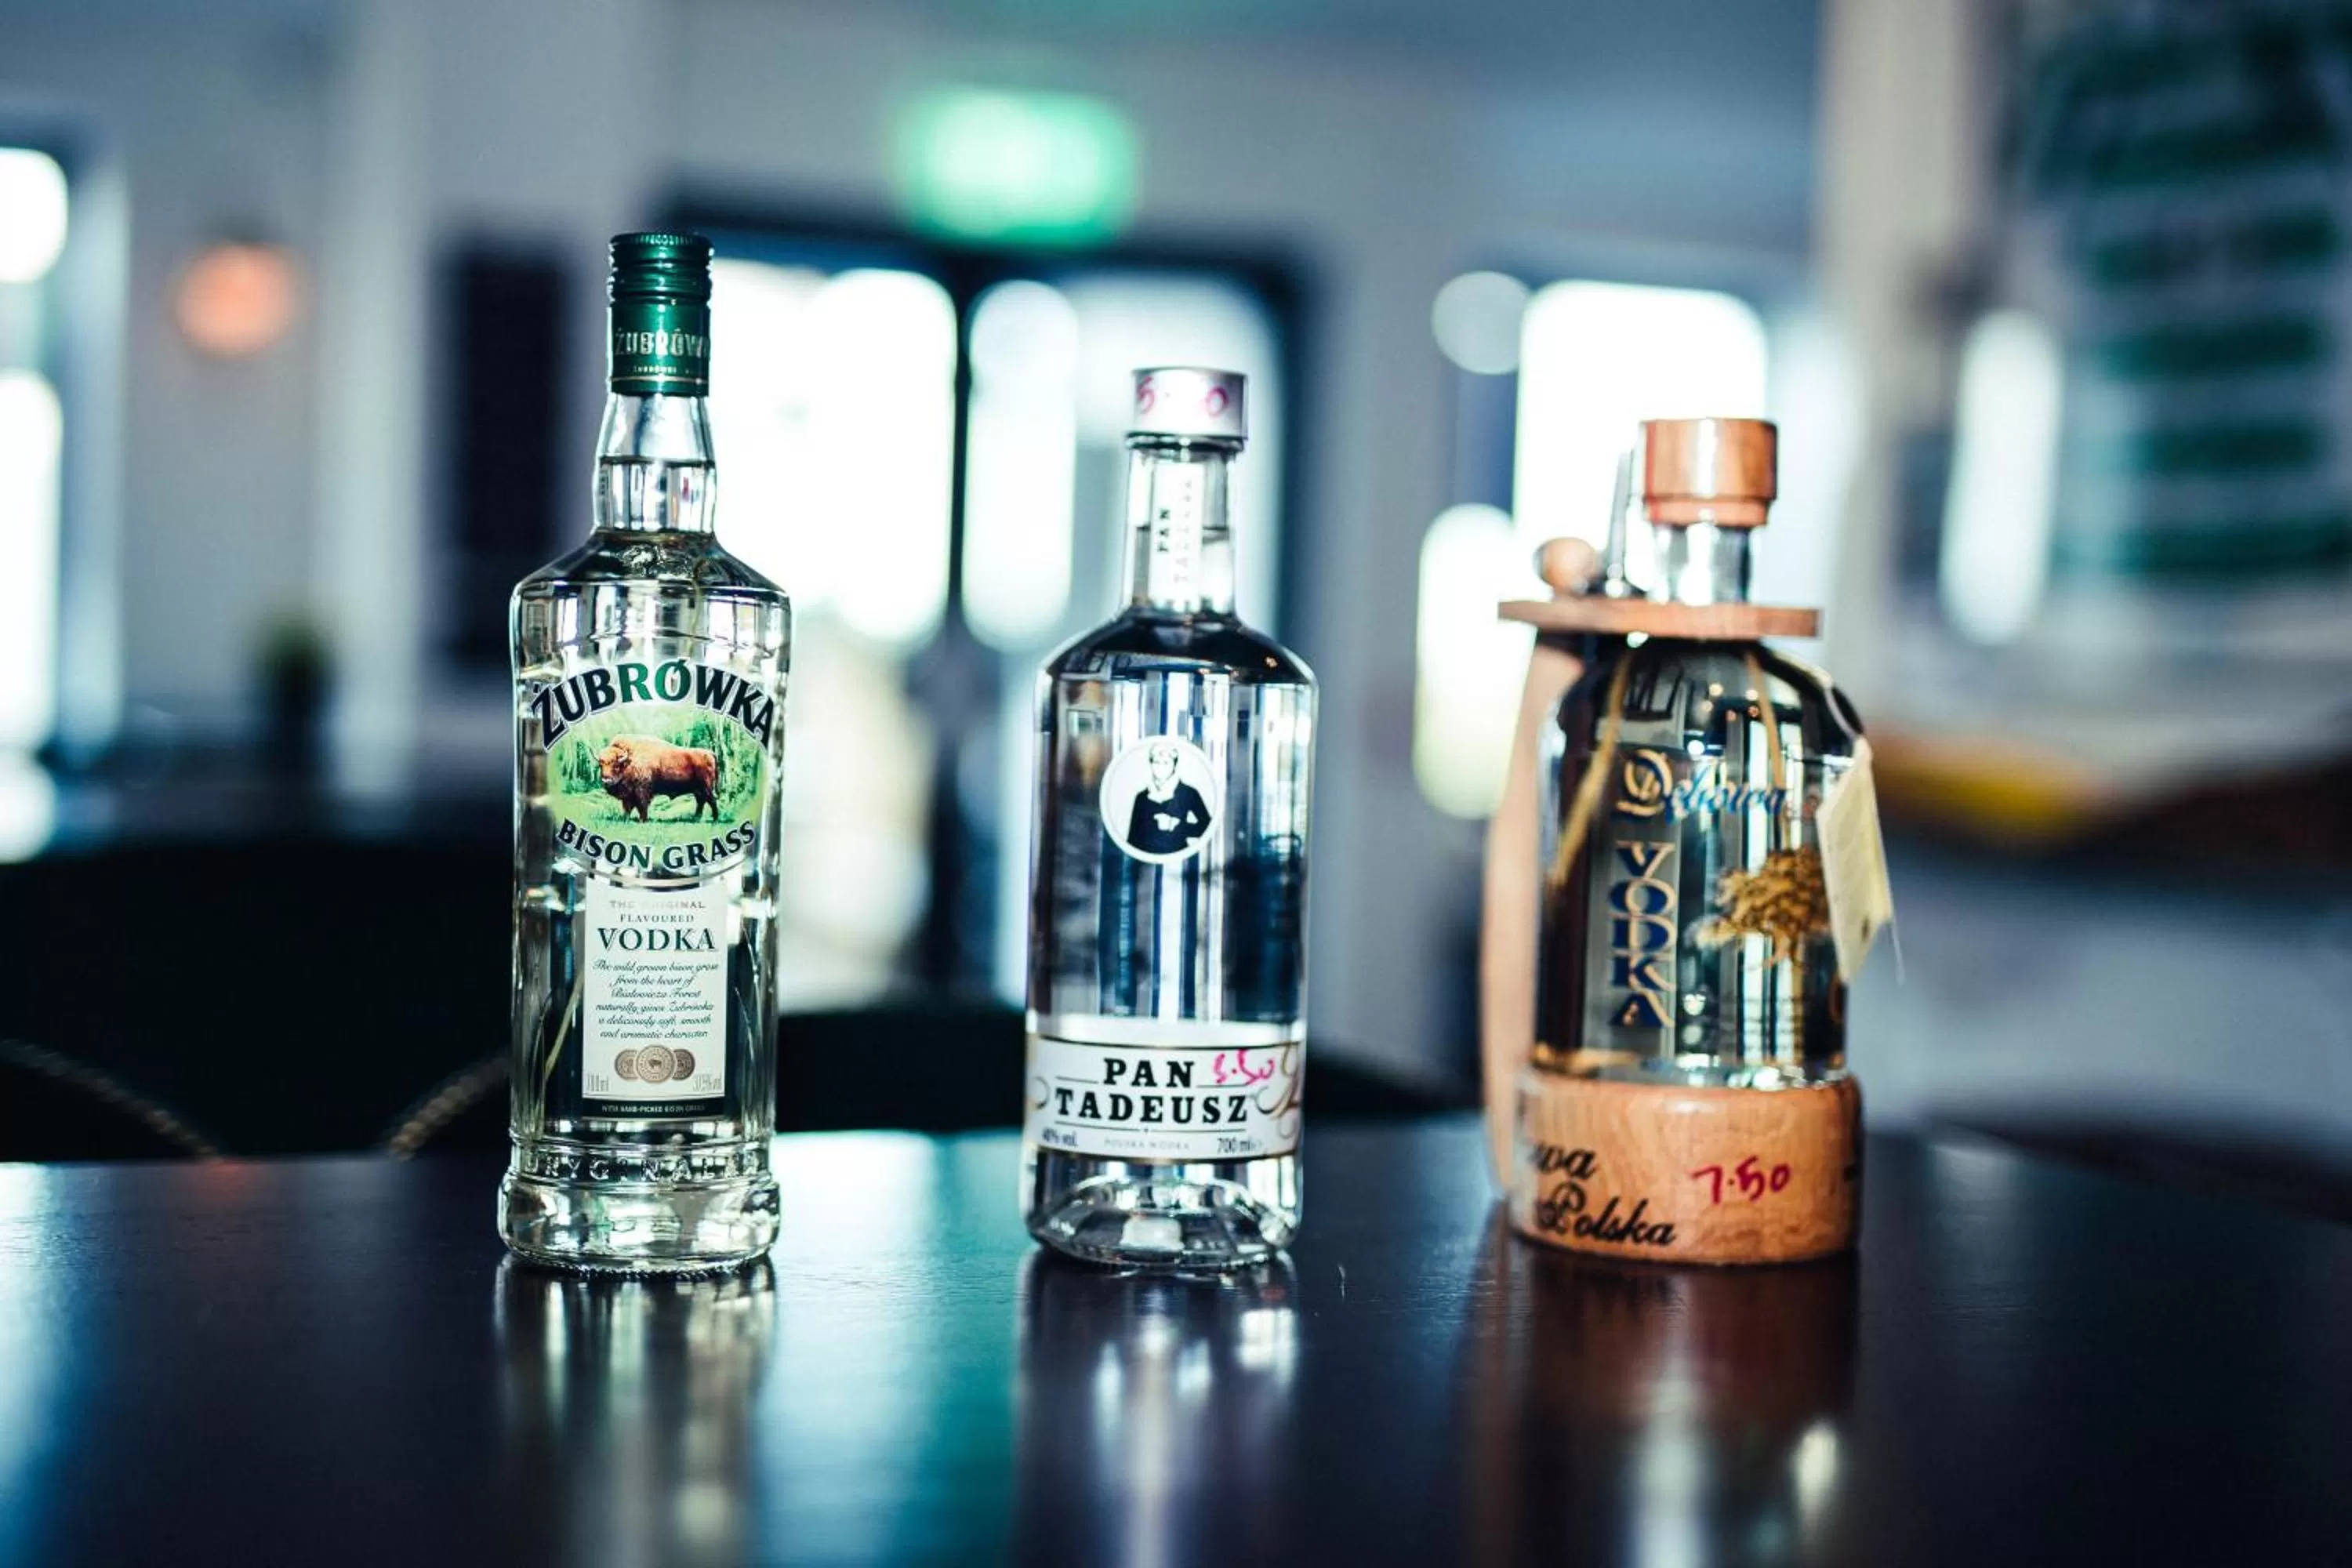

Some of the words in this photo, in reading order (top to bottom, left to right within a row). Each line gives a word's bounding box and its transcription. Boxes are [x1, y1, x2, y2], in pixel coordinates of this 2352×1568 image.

[614, 326, 710, 358] ŻUBRÓW
[530, 659, 775, 750] ŻUBRÓWKA
[557, 818, 651, 869] BISON
[662, 821, 755, 869] GRASS
[597, 927, 719, 952] VODKA
[619, 913, 695, 923] FLAVOURED
[1609, 840, 1677, 1029] VODKA
[1102, 1058, 1195, 1088] PAN
[1054, 1087, 1249, 1123] TADEUSZ
[1691, 1155, 1792, 1205] 7.50
[1537, 1181, 1676, 1247] Polska
